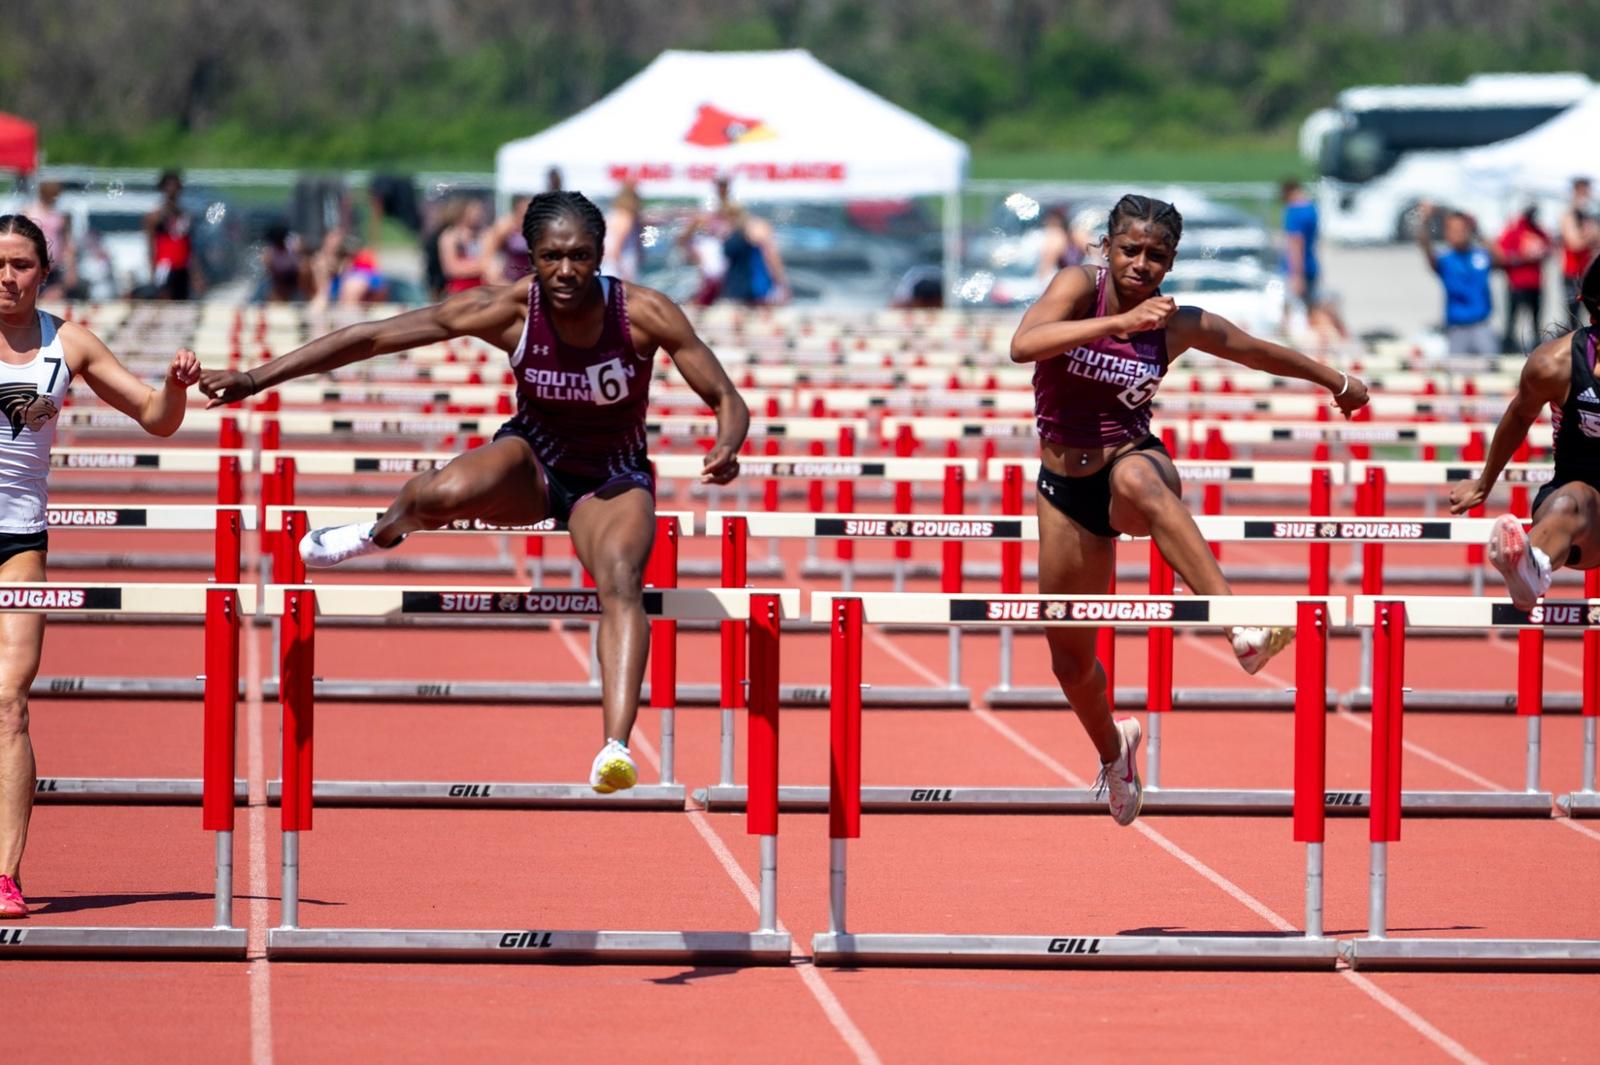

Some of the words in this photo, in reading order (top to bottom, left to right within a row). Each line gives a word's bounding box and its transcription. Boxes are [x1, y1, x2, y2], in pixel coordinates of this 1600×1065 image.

[44, 357, 61, 393] 7
[524, 364, 635, 388] SOUTHN
[598, 364, 620, 401] 6
[1067, 360, 1141, 390] ILLINOI
[67, 455, 136, 468] COUGARS
[45, 510, 118, 525] OUGARS
[845, 520, 886, 536] SIUE
[911, 521, 993, 537] COUGARS
[1275, 522, 1316, 537] SIUE
[1341, 523, 1423, 538] COUGARS
[441, 594, 493, 611] SIUE
[525, 594, 602, 612] COUGA
[988, 602, 1039, 619] SIUE
[1072, 602, 1174, 620] COUGARS
[1529, 606, 1581, 624] SIUE
[448, 784, 491, 798] GILL
[910, 789, 953, 802] GILL
[1325, 793, 1363, 805] GILL
[499, 932, 552, 948] GILL
[1047, 938, 1101, 954] GILL
